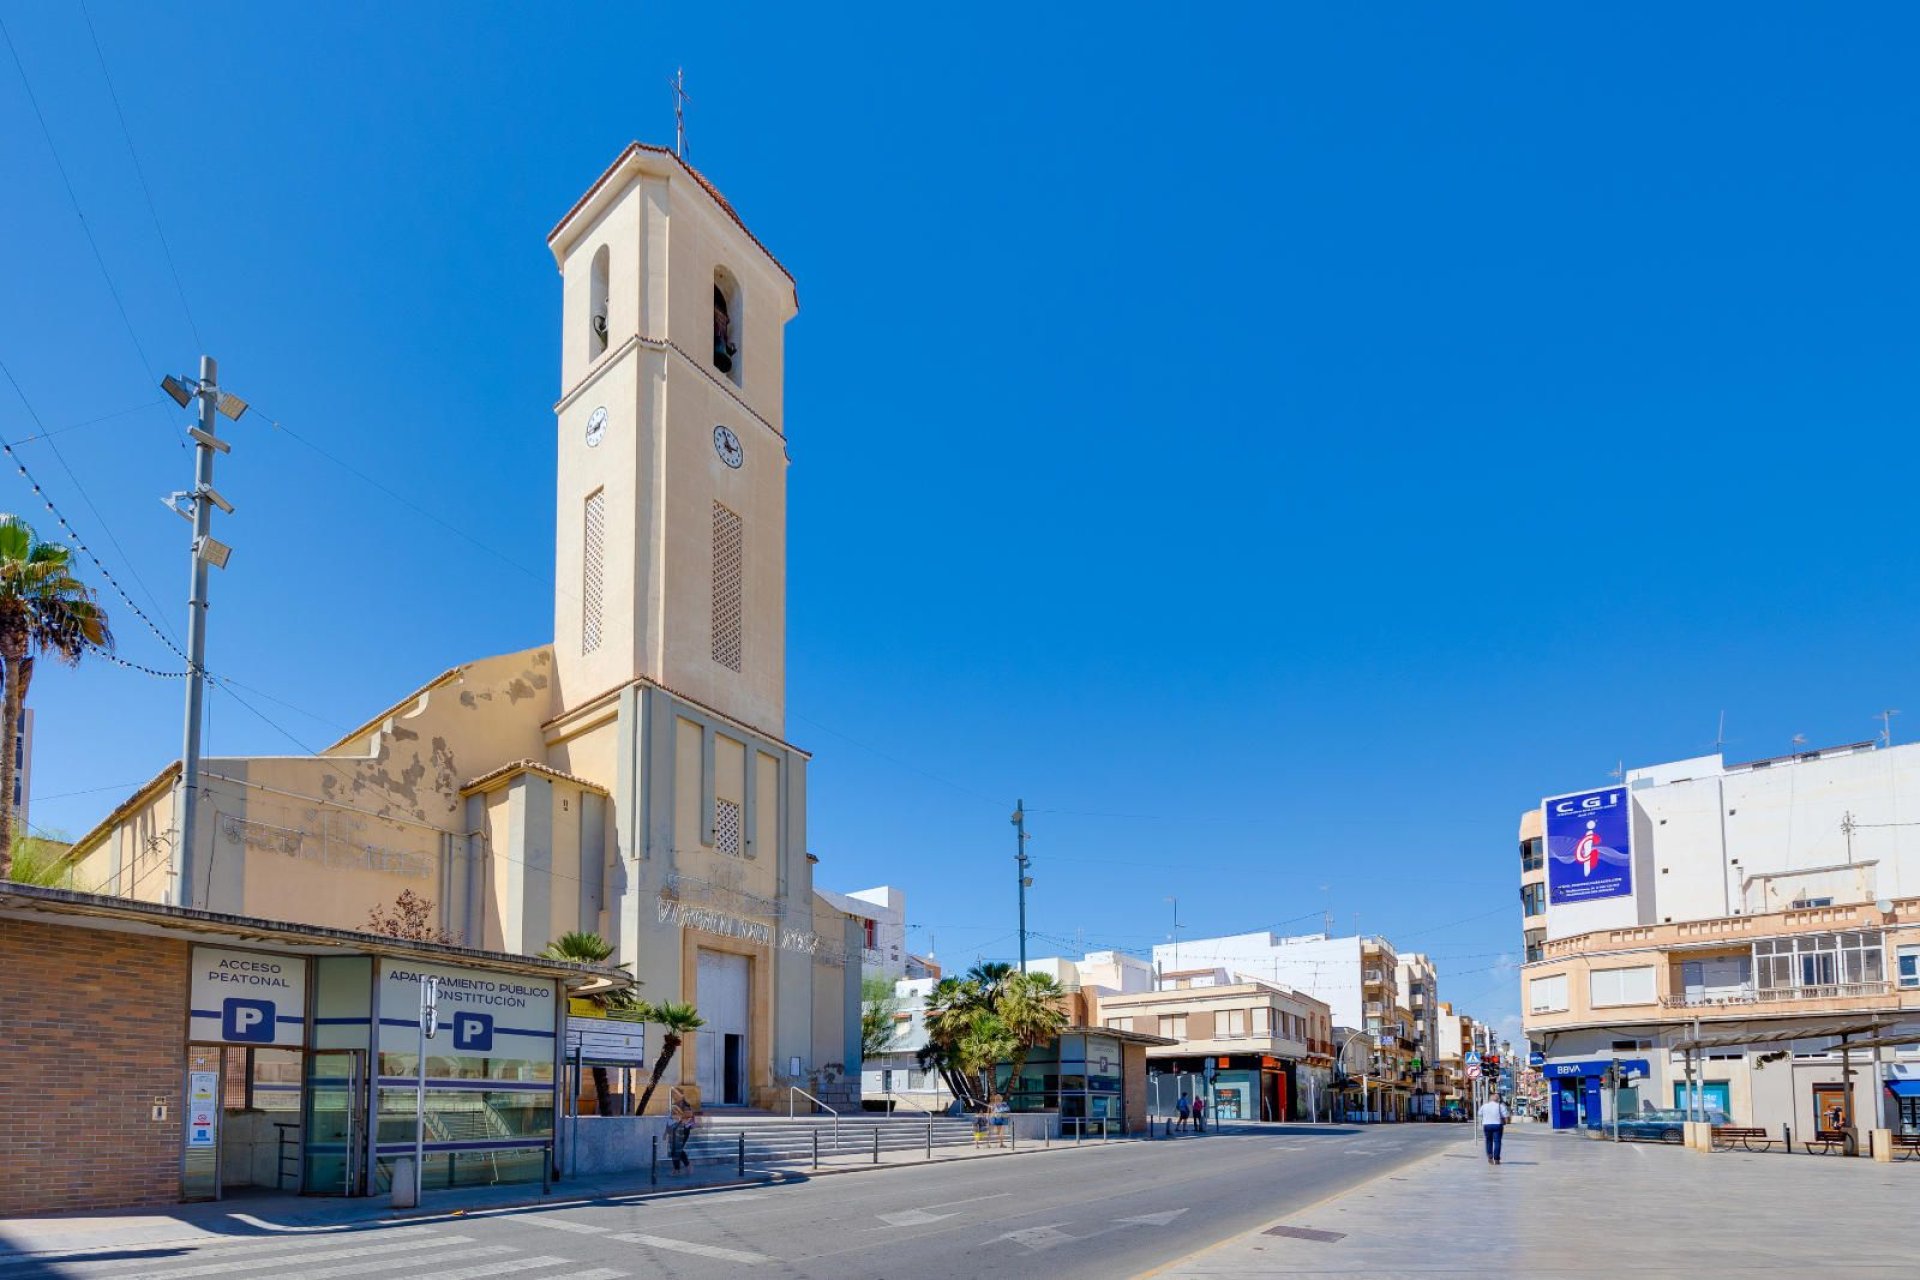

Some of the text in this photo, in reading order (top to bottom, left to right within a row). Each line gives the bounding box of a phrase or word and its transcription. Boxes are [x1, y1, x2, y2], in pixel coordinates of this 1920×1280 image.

[1556, 793, 1618, 813] CGI
[219, 959, 282, 974] ACCESO
[208, 971, 290, 988] PEATONAL
[436, 988, 526, 1008] ONSTITUCIÓN
[499, 982, 549, 998] PÚBLICO
[235, 1007, 263, 1034] P
[462, 1019, 484, 1043] P
[1557, 1065, 1581, 1075] BBVA
